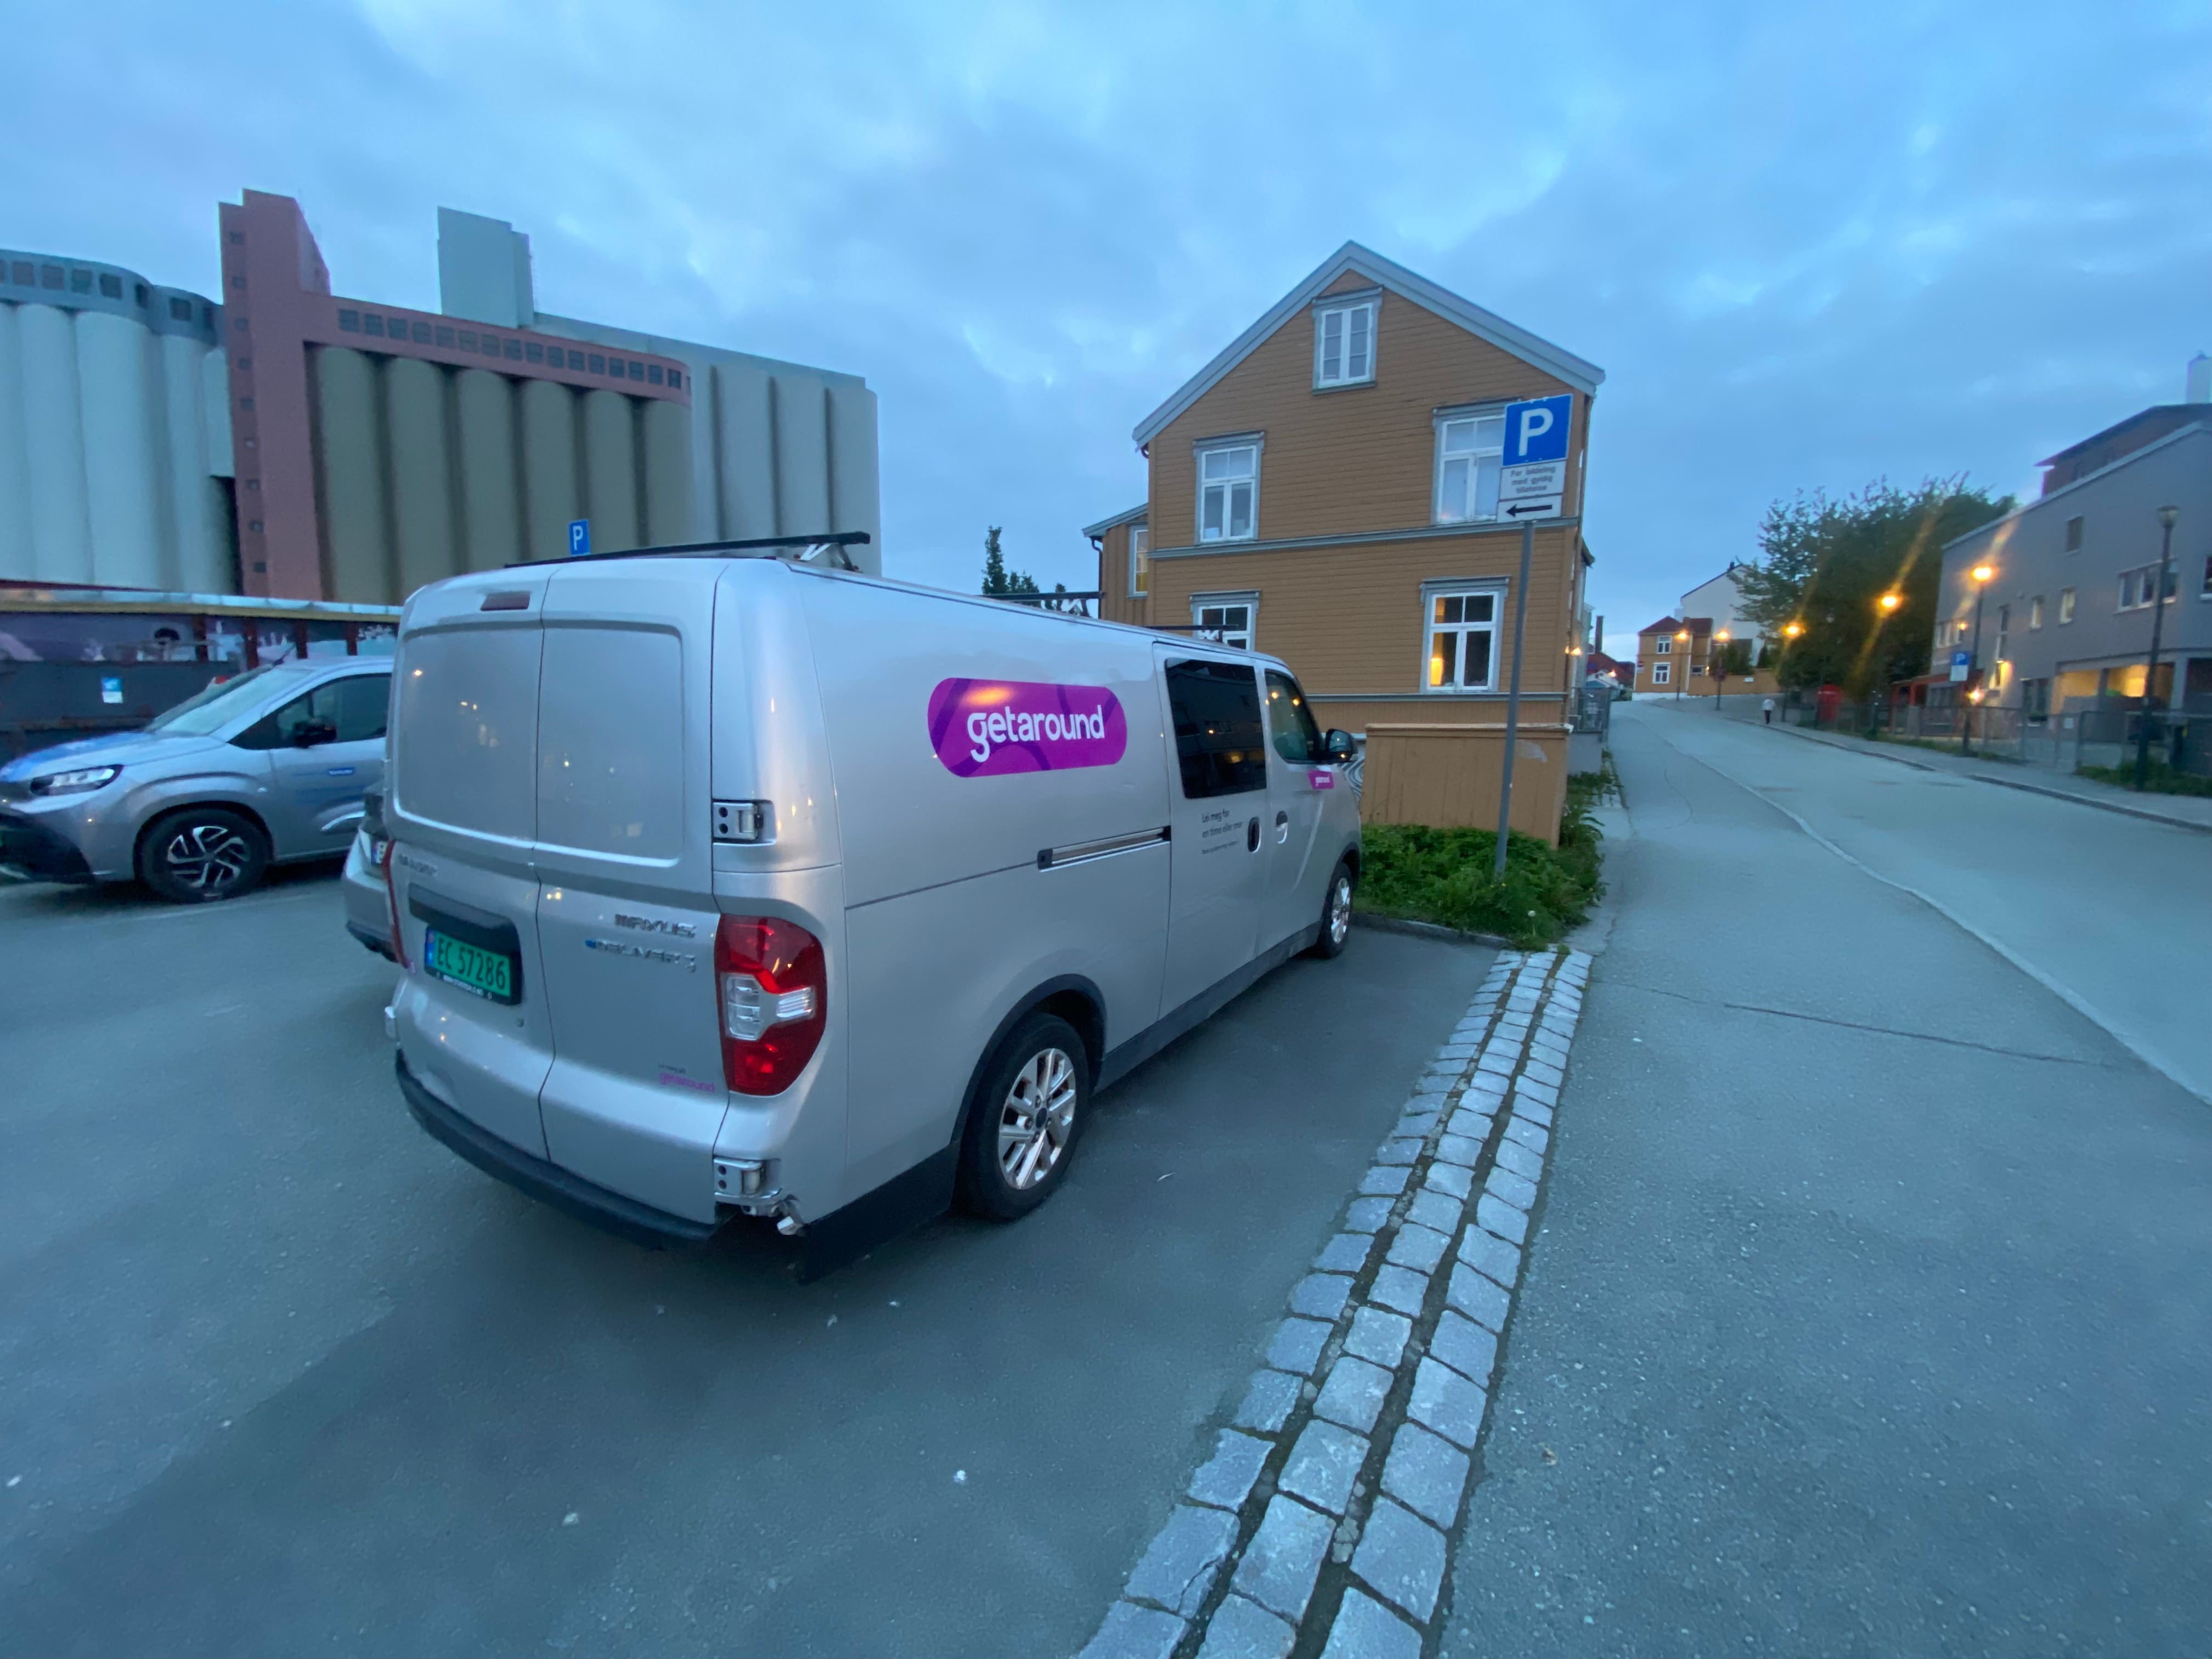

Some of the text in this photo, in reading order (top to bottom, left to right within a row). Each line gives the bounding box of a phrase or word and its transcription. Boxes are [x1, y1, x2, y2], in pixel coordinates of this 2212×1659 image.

[1518, 408, 1554, 456] P
[573, 526, 583, 551] P
[1956, 653, 1966, 663] P
[967, 704, 1105, 762] getaround
[437, 937, 453, 970] EC
[458, 946, 506, 990] 57286
